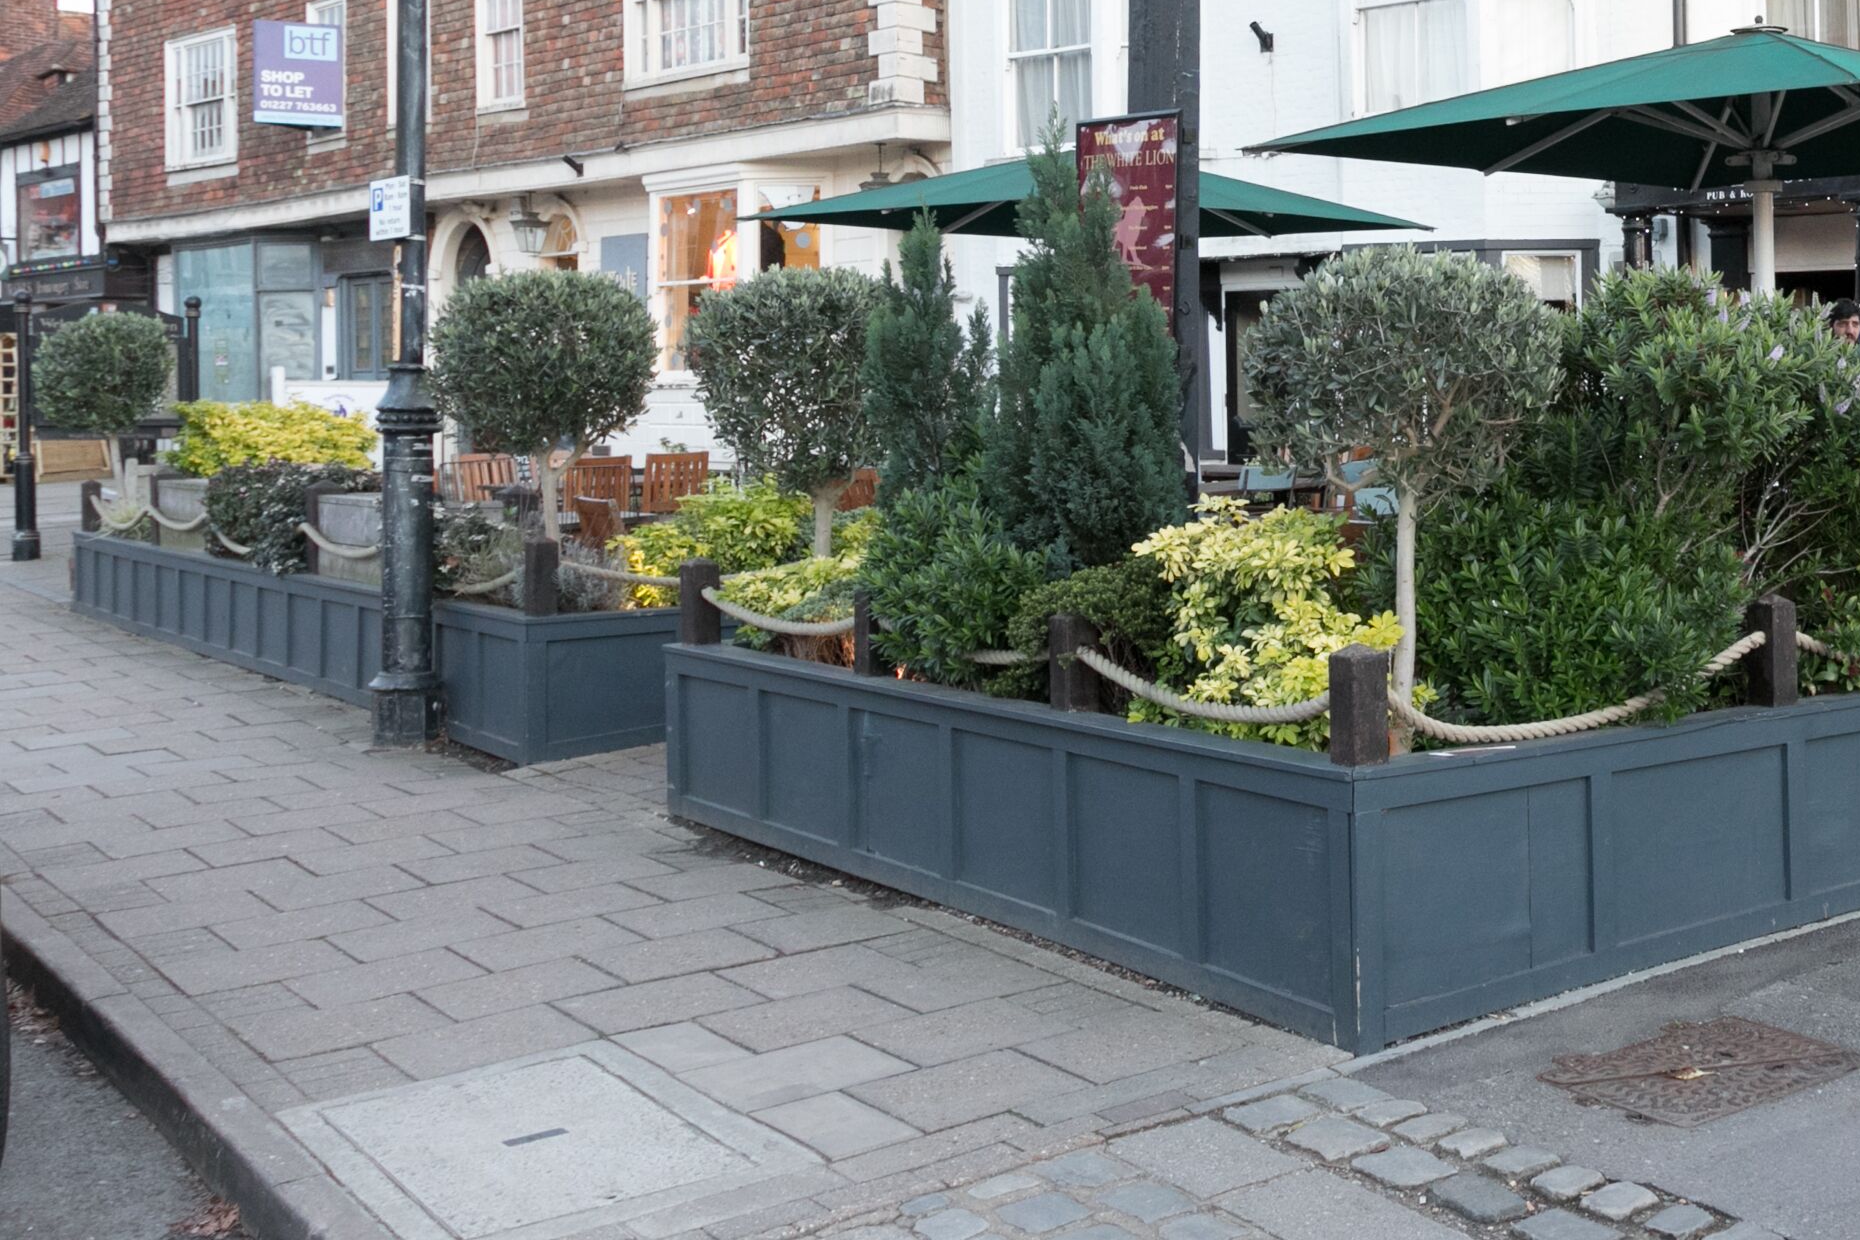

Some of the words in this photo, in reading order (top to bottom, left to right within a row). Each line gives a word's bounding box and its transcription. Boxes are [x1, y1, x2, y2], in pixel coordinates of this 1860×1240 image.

[288, 29, 332, 57] btf
[260, 69, 305, 84] SHOP
[260, 83, 283, 97] TO
[285, 85, 314, 98] LET
[260, 99, 293, 110] 01227
[294, 101, 337, 113] 763663
[1094, 129, 1132, 146] What's
[1133, 130, 1149, 143] on
[1151, 127, 1165, 141] at
[1106, 150, 1143, 168] WHITE
[1145, 148, 1175, 166] LION
[1706, 191, 1726, 200] PUB
[1729, 190, 1736, 199] &
